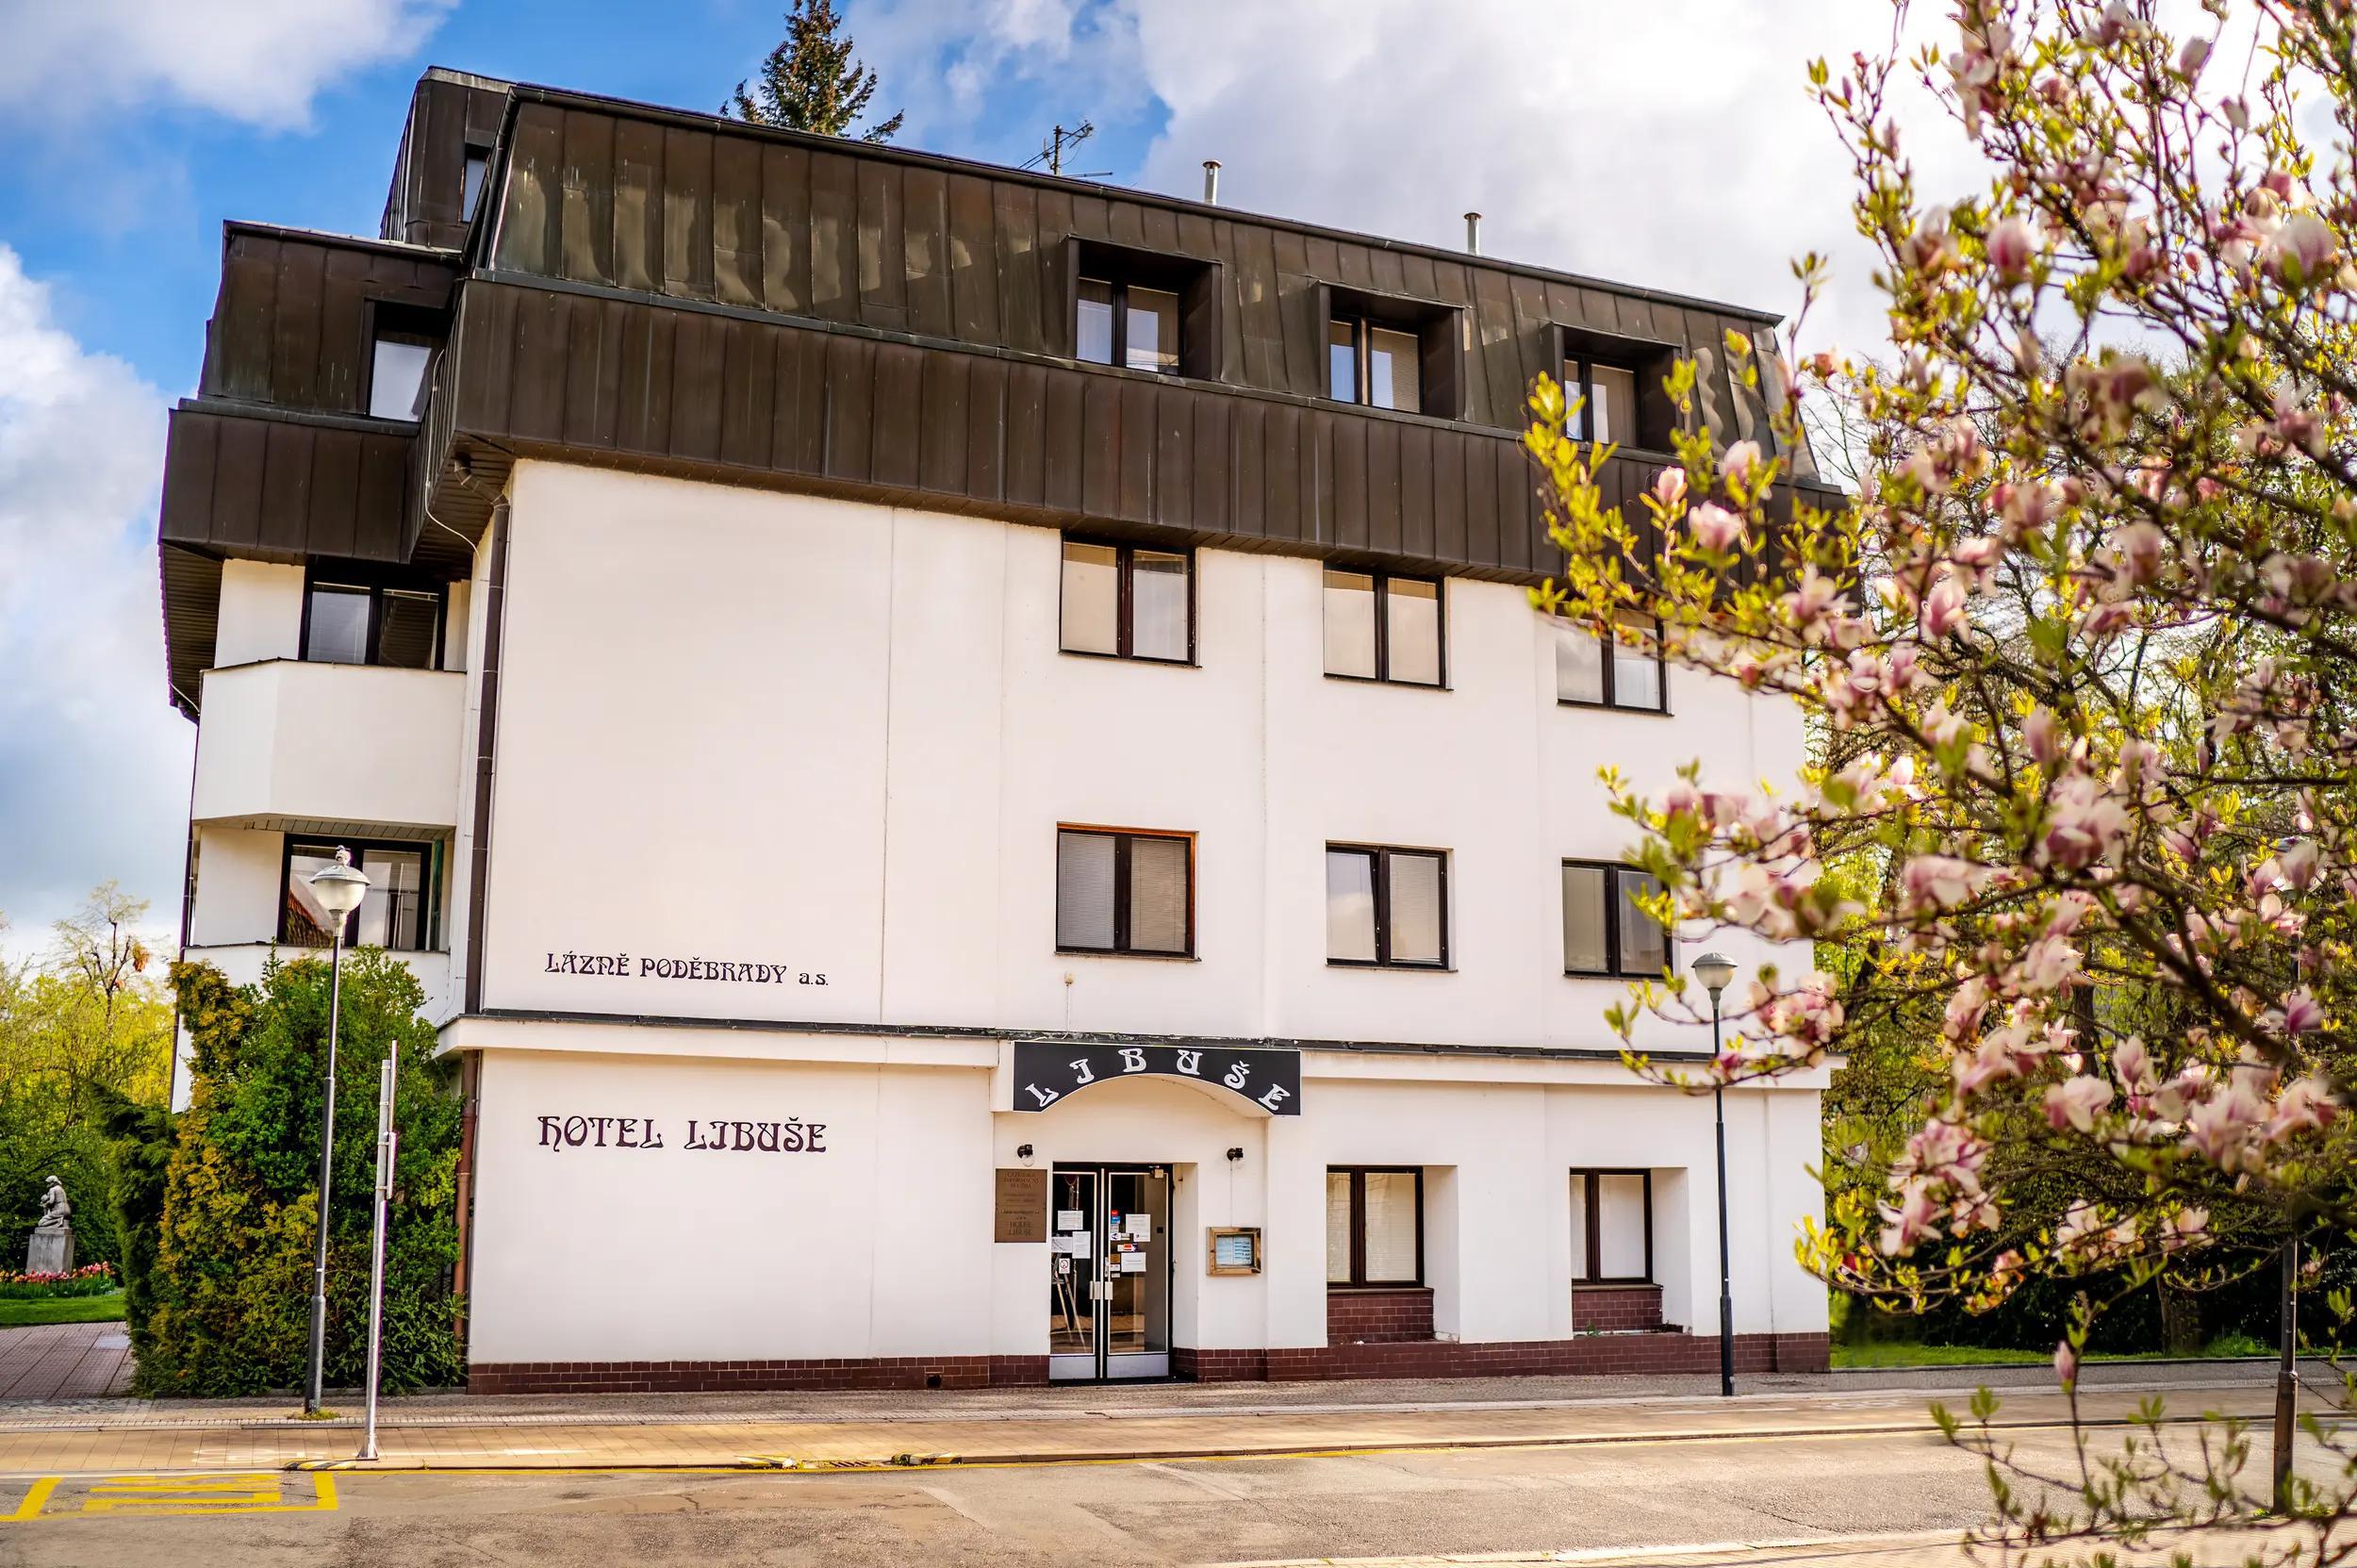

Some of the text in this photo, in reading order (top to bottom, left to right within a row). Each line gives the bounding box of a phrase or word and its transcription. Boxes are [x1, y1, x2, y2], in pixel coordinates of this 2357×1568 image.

[545, 951, 829, 986] LÁZNĚ PODĚBRADY a.s.
[537, 1116, 664, 1152] HOTEL
